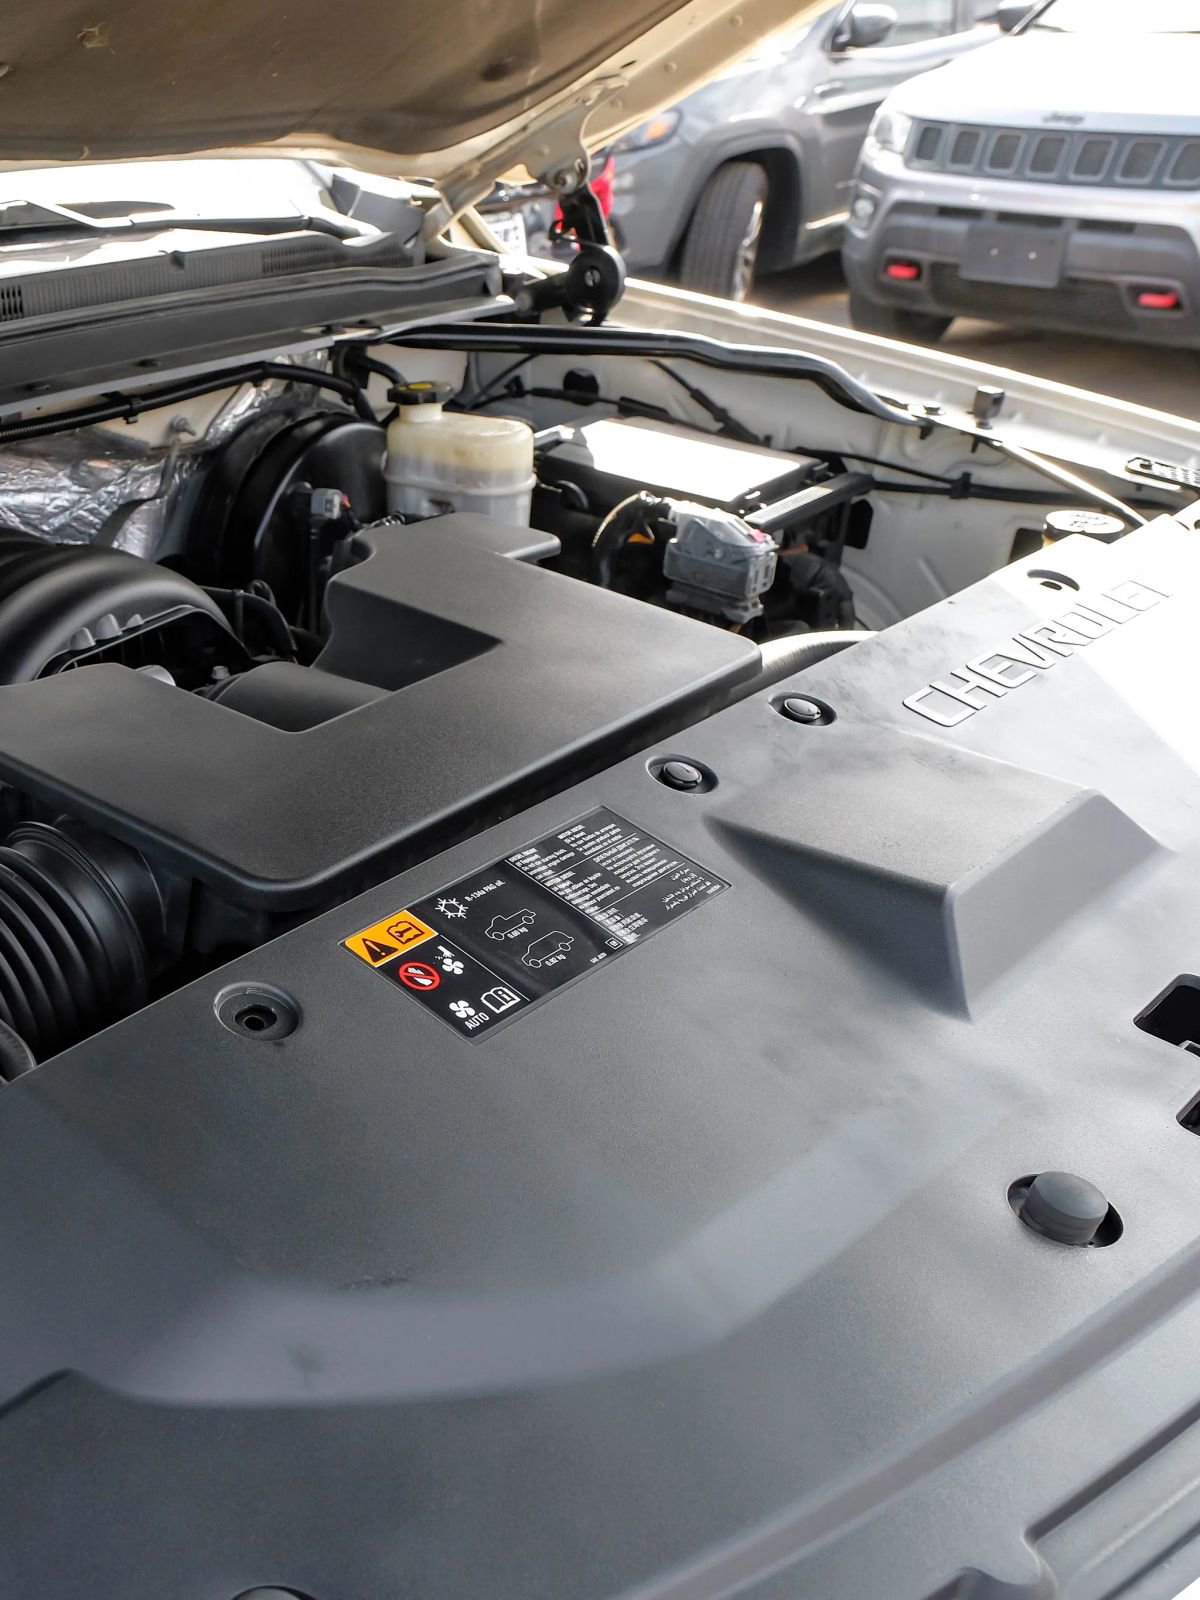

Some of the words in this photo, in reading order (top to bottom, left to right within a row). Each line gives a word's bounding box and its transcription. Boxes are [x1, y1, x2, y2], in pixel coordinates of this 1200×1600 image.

[902, 579, 1173, 727] CHEVROLET
[464, 889, 486, 902] R-134a
[483, 884, 497, 892] PAG
[518, 926, 528, 934] kg
[464, 1012, 489, 1030] AUTO
